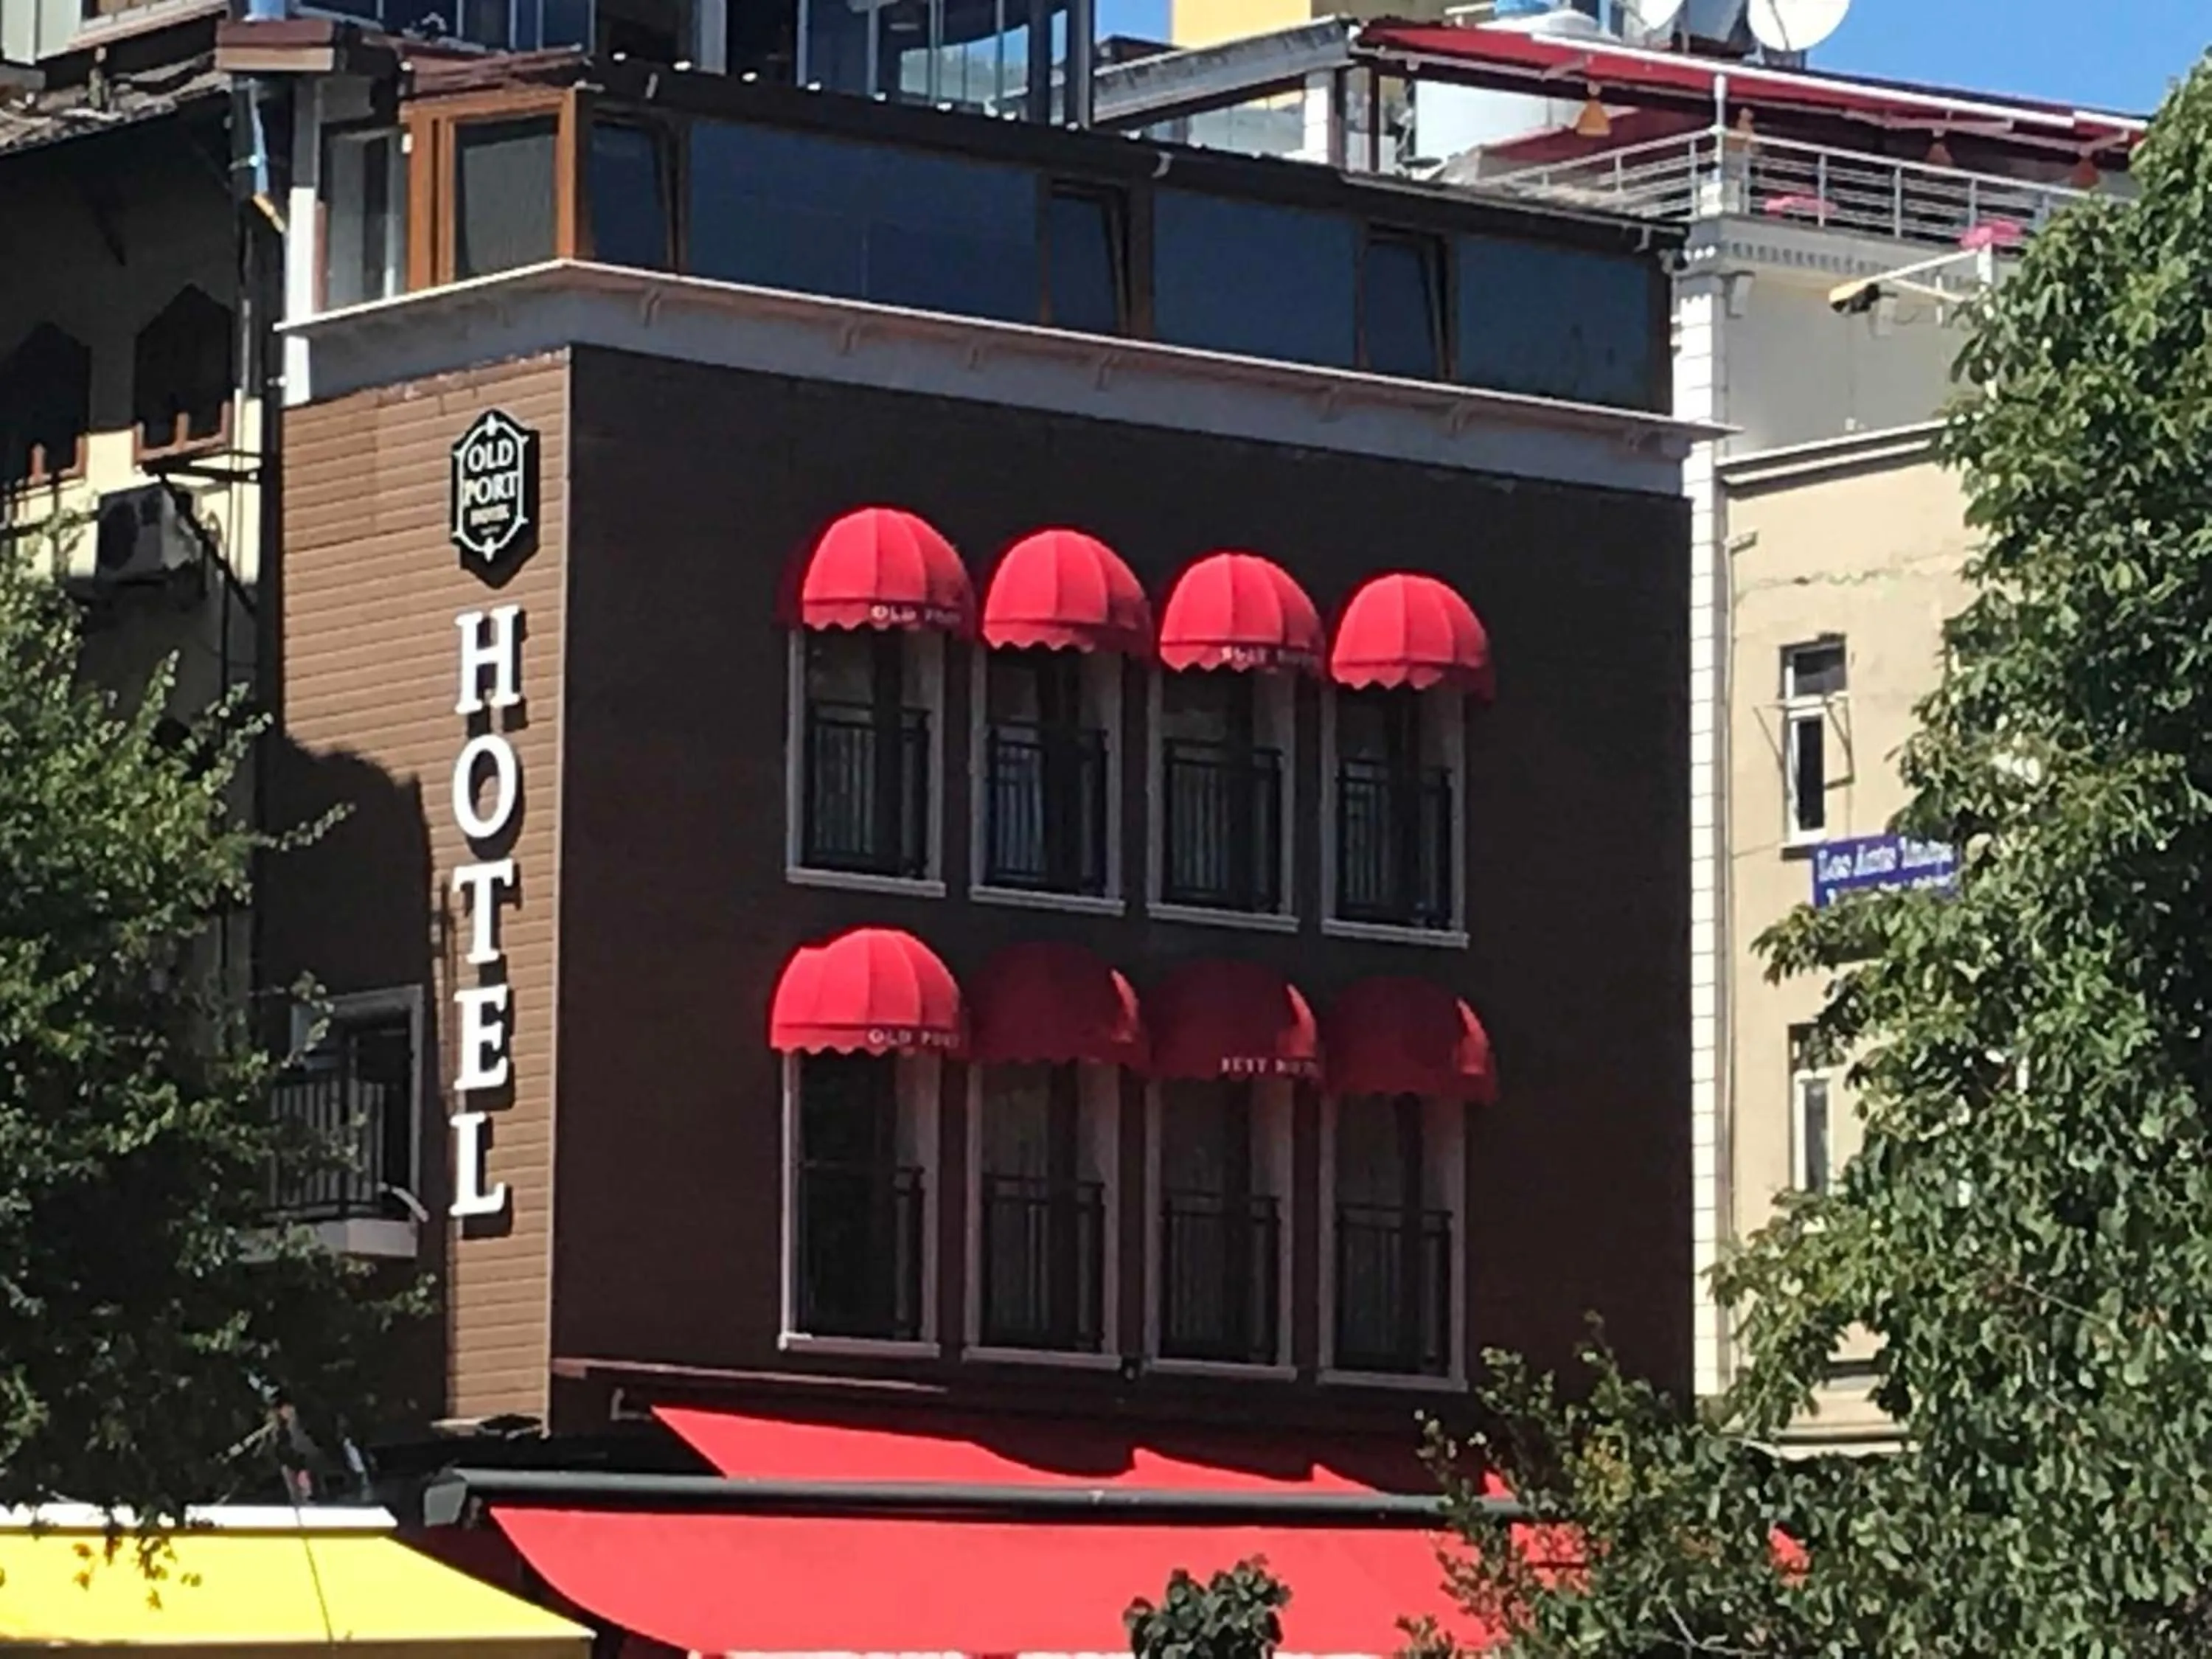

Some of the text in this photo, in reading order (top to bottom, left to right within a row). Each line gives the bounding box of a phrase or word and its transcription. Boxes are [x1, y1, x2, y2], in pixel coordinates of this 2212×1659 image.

[467, 439, 514, 473] OLD
[464, 471, 518, 507] PORT
[449, 604, 521, 1217] HOTEL
[868, 1027, 913, 1046] OLD
